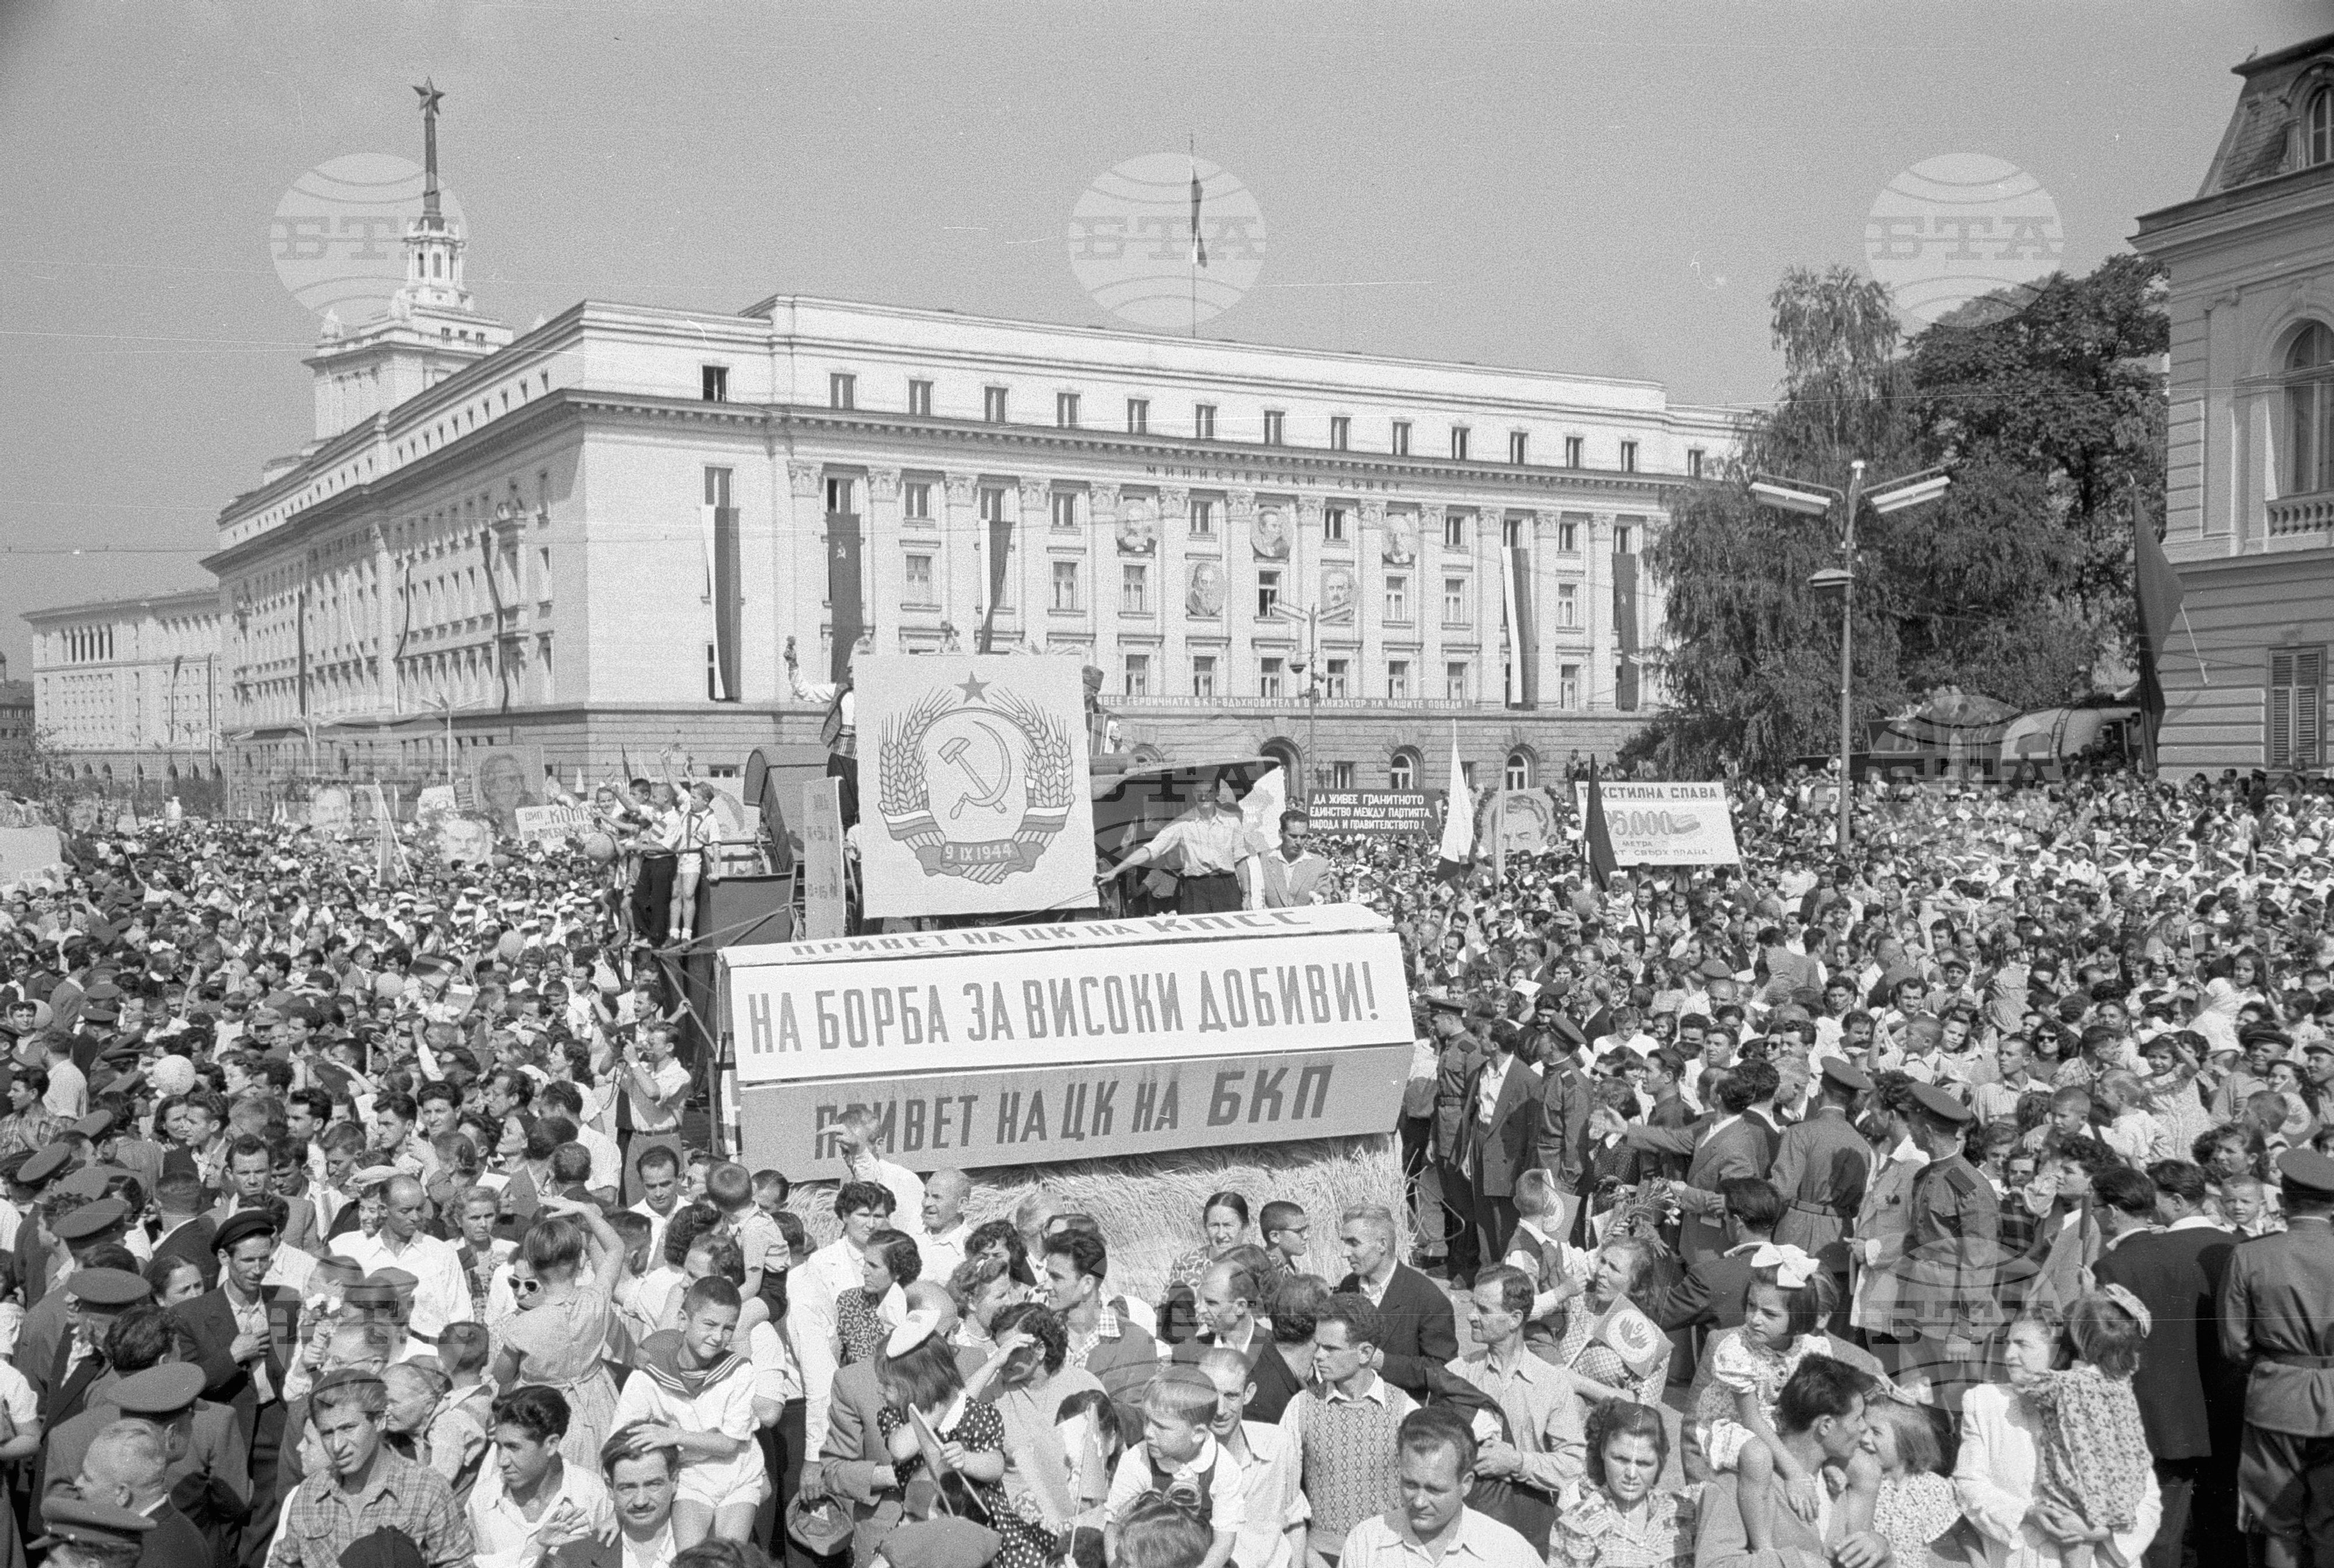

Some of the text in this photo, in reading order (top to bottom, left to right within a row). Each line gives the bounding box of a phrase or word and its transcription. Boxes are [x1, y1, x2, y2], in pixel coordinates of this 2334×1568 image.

[1145, 466, 1316, 487] МИНИСТЕРСКИ
[1096, 696, 1123, 706] ИВЕЕ
[1127, 696, 1190, 707] ГЕРОИЧНАТА
[1294, 699, 1300, 708] И
[1304, 699, 1366, 709] ОАНИЗАТОР
[1371, 700, 1383, 708] НА
[1387, 700, 1424, 709] НАШИТЕ
[1580, 787, 1718, 799] ТКСТИЛНА СЛАВА
[1313, 794, 1424, 806] ДА ЖИВЕЕ ГРАНИТНОТО
[1309, 806, 1351, 818] ЕДИНСТВО
[1353, 807, 1386, 818] МЕЖДУ
[1309, 819, 1339, 830] НАРОДА
[1342, 819, 1348, 829] И
[945, 843, 1013, 861] 9 IX 1944
[1635, 849, 1670, 857] СВЪРХ
[791, 911, 1311, 956] ПРИВЕТ НА ЦК НА КПСС
[748, 961, 1376, 1054] НА БОРБА ЗА ВИСОКИ ДОБИВИ!
[815, 1064, 1334, 1160] ПИВЕТ НА ЦК НА БКП
